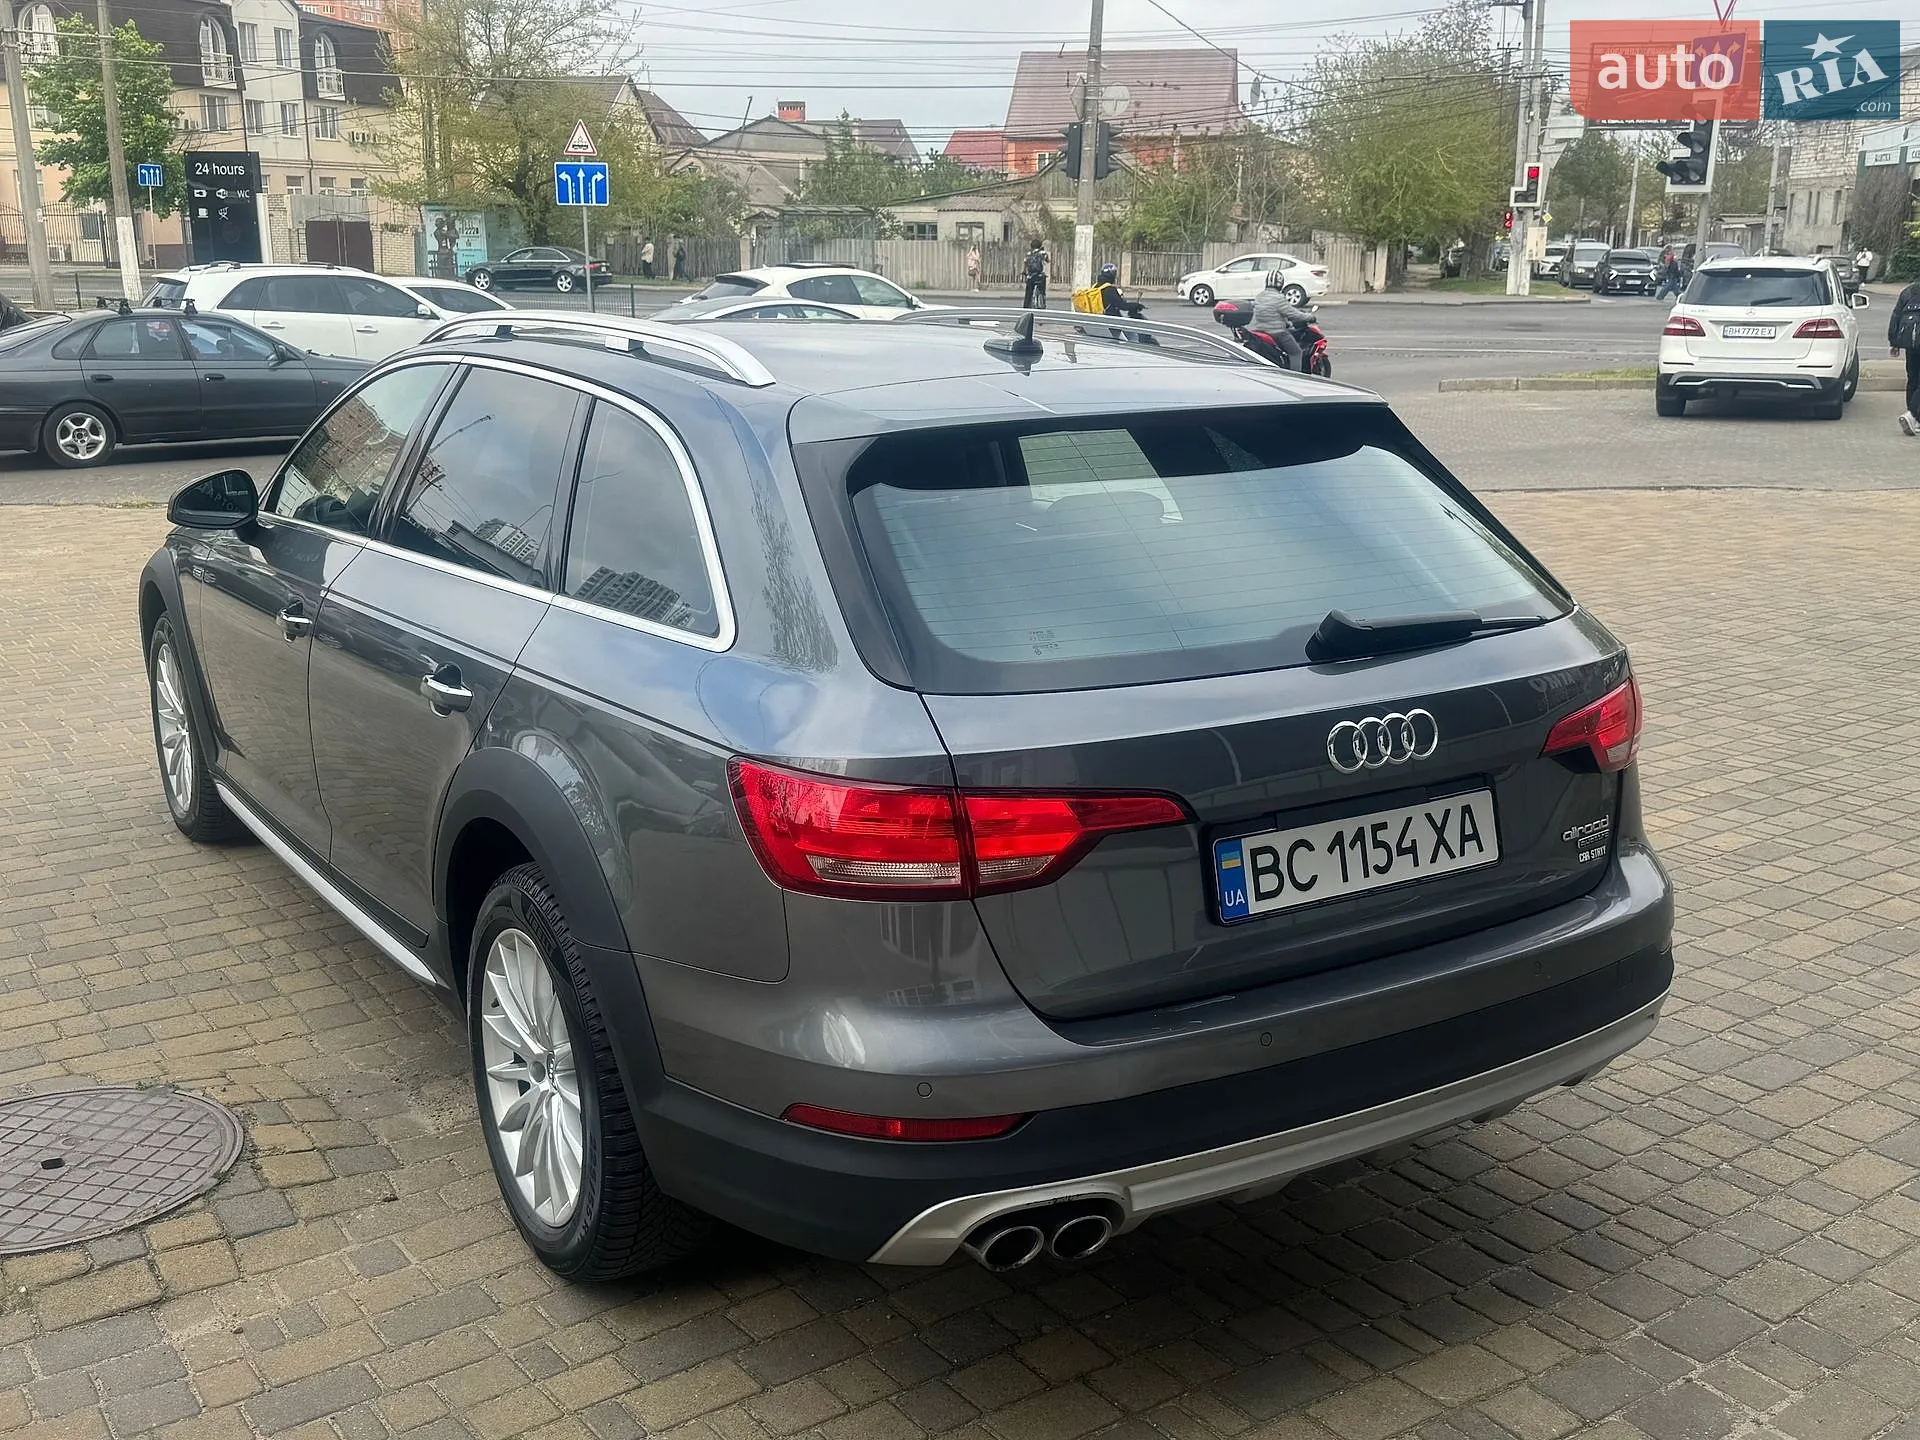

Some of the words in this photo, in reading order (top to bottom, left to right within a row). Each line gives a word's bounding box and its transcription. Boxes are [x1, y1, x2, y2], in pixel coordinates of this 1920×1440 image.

[194, 162, 209, 175] 24
[212, 162, 245, 175] hours
[237, 189, 250, 198] WC
[1741, 327, 1760, 336] 7772
[1760, 327, 1773, 336] EX
[1562, 814, 1609, 842] allroad
[1249, 838, 1319, 902] BC
[1327, 816, 1419, 883] 1154
[1424, 803, 1484, 864] XA
[1578, 851, 1591, 863] CAR
[1224, 888, 1246, 907] UA
